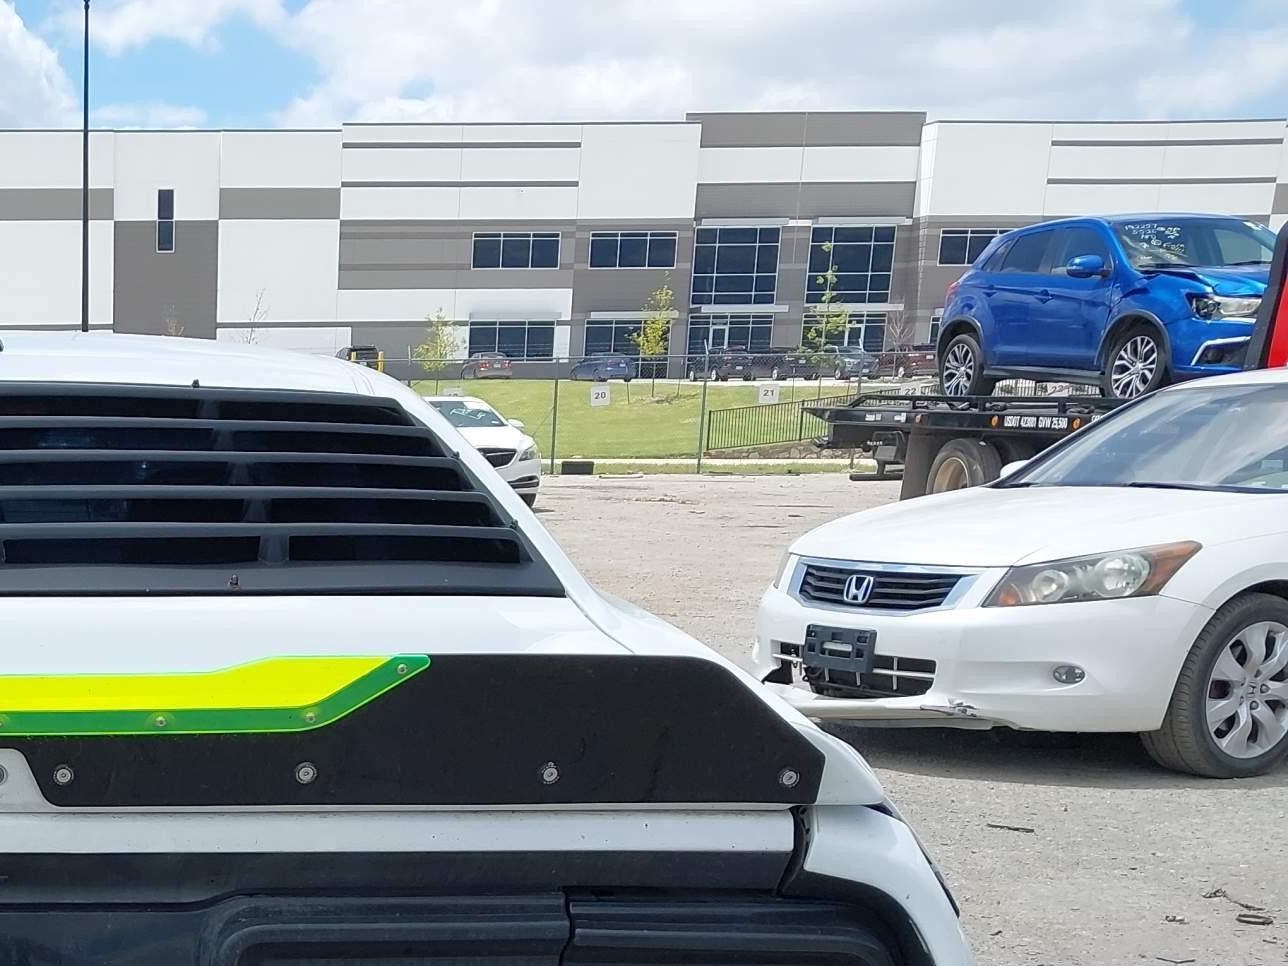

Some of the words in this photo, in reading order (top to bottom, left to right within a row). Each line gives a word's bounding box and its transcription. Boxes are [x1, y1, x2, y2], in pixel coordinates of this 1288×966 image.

[594, 391, 607, 400] 20
[762, 389, 775, 397] 21
[1004, 415, 1021, 427] USDOT
[1038, 416, 1052, 428] GVW
